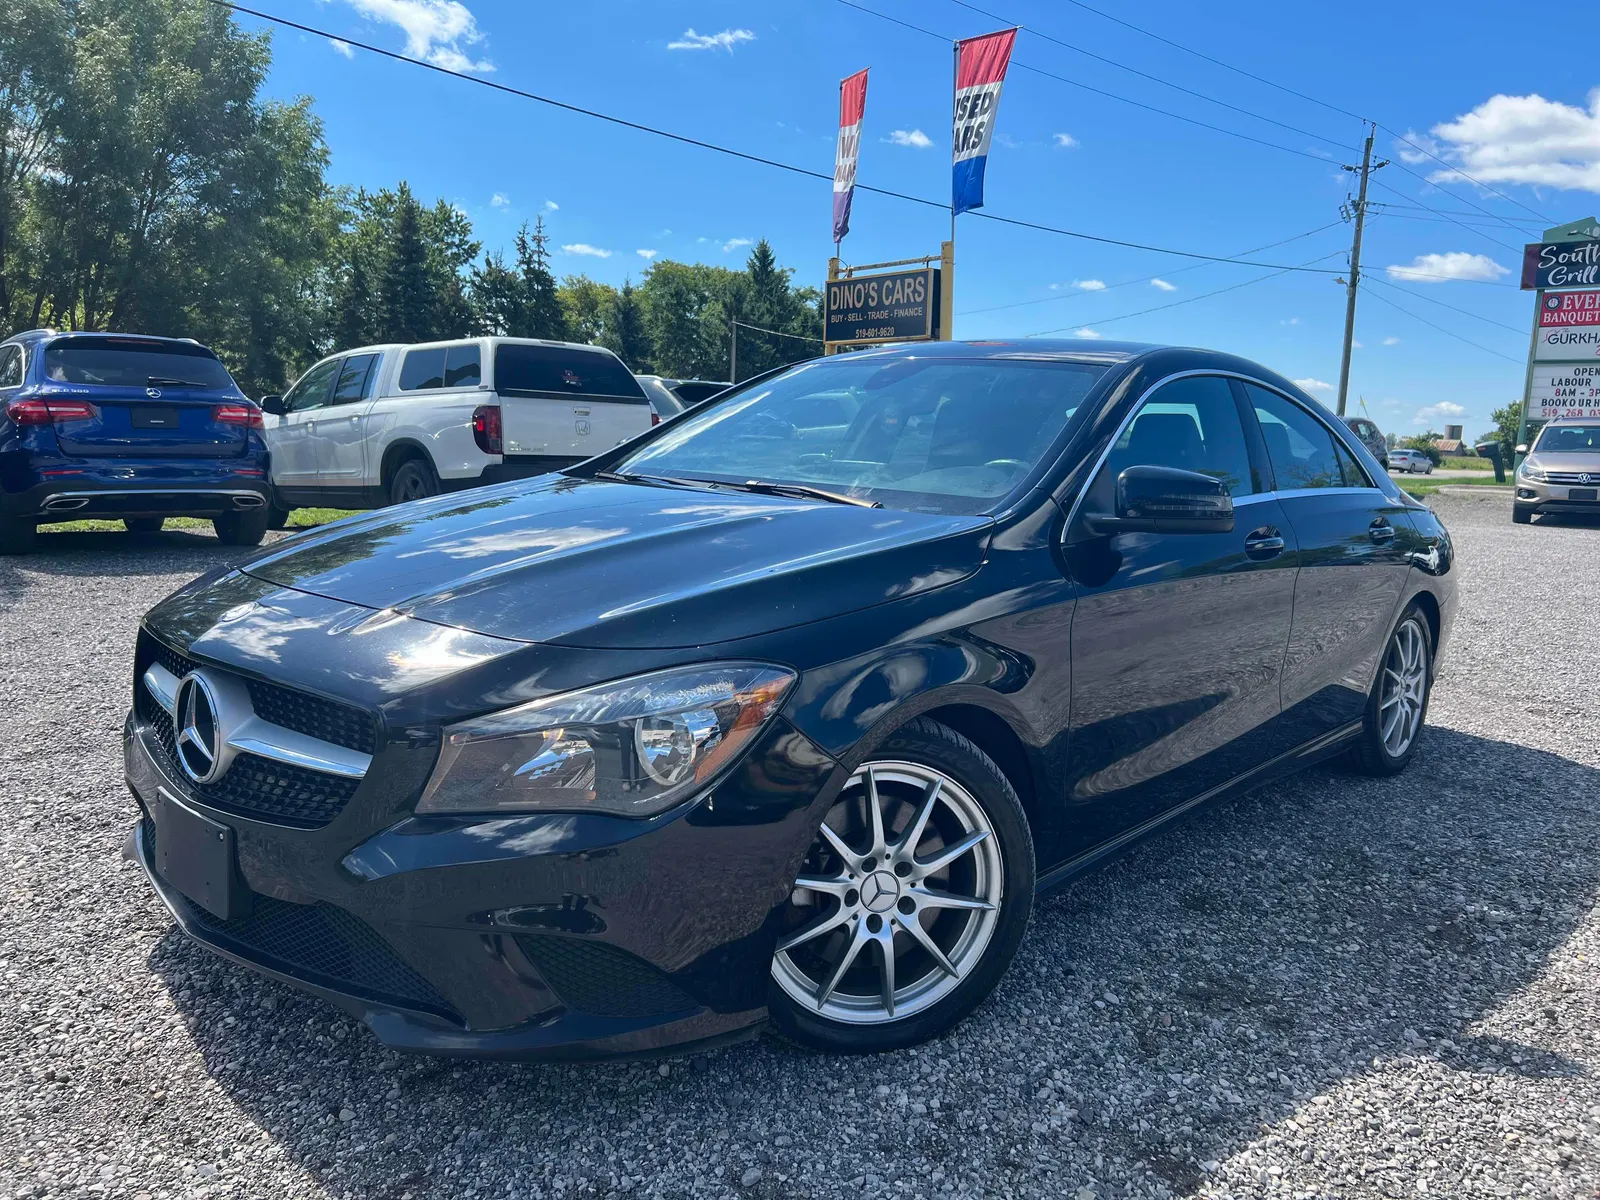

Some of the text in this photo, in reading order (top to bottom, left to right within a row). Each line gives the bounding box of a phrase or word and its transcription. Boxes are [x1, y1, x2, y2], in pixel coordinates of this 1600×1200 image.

[1548, 265, 1598, 286] Grill
[830, 276, 924, 310] DINO'S CARS
[830, 314, 843, 323] BUY
[848, 312, 863, 322] SELL
[868, 310, 889, 320] TRADE
[894, 307, 923, 318] FINANCE
[855, 326, 895, 339] 519-601-9620
[1551, 378, 1592, 386] LABOUR
[1555, 387, 1576, 397] 8AM
[1542, 408, 1558, 417] 519
